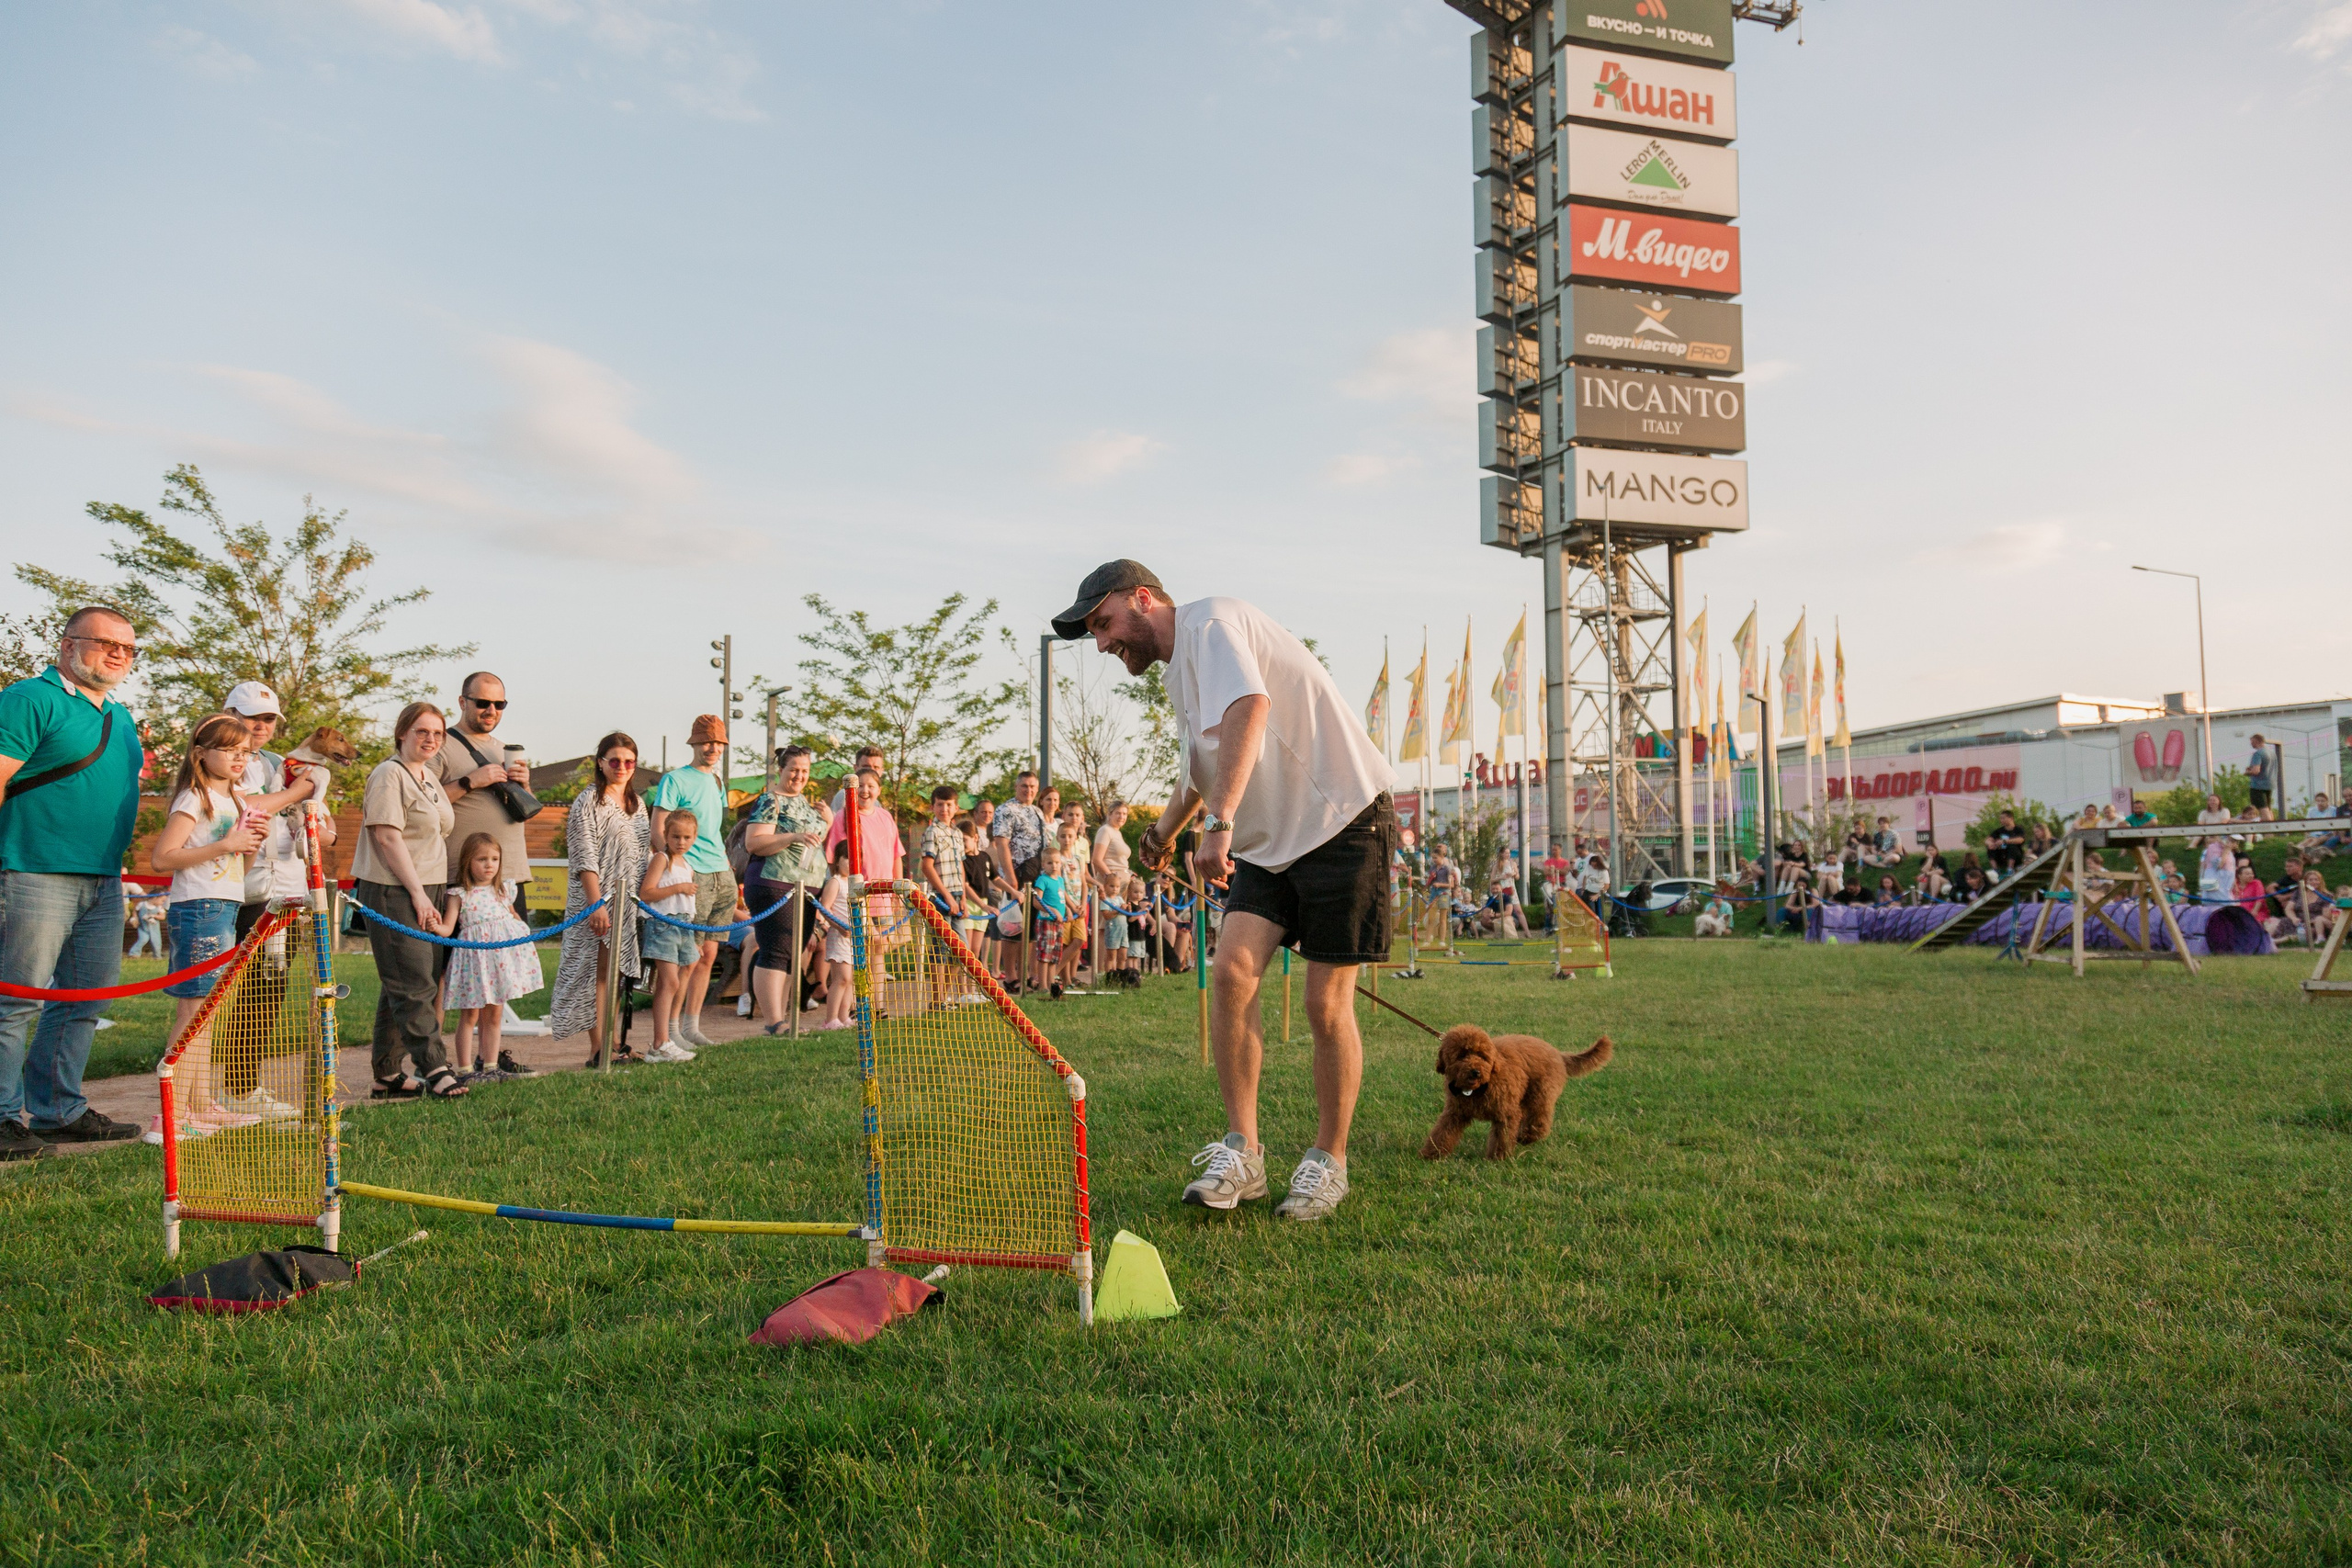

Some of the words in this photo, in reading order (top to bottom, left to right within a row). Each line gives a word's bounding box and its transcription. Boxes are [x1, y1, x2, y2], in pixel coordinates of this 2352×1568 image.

[1587, 15, 1643, 35] ВКУСНО
[1657, 26, 1667, 39] И
[1669, 28, 1714, 48] ТОЧКА
[1593, 61, 1714, 126] Ашан
[1620, 147, 1652, 182] LEROY
[1649, 140, 1691, 189] MERLIN
[1582, 217, 1730, 278] М.видео
[1690, 346, 1728, 362] PRO
[1582, 377, 1739, 420] INCANTO
[1642, 419, 1683, 435] ITALY
[1587, 468, 1739, 508] MANGO
